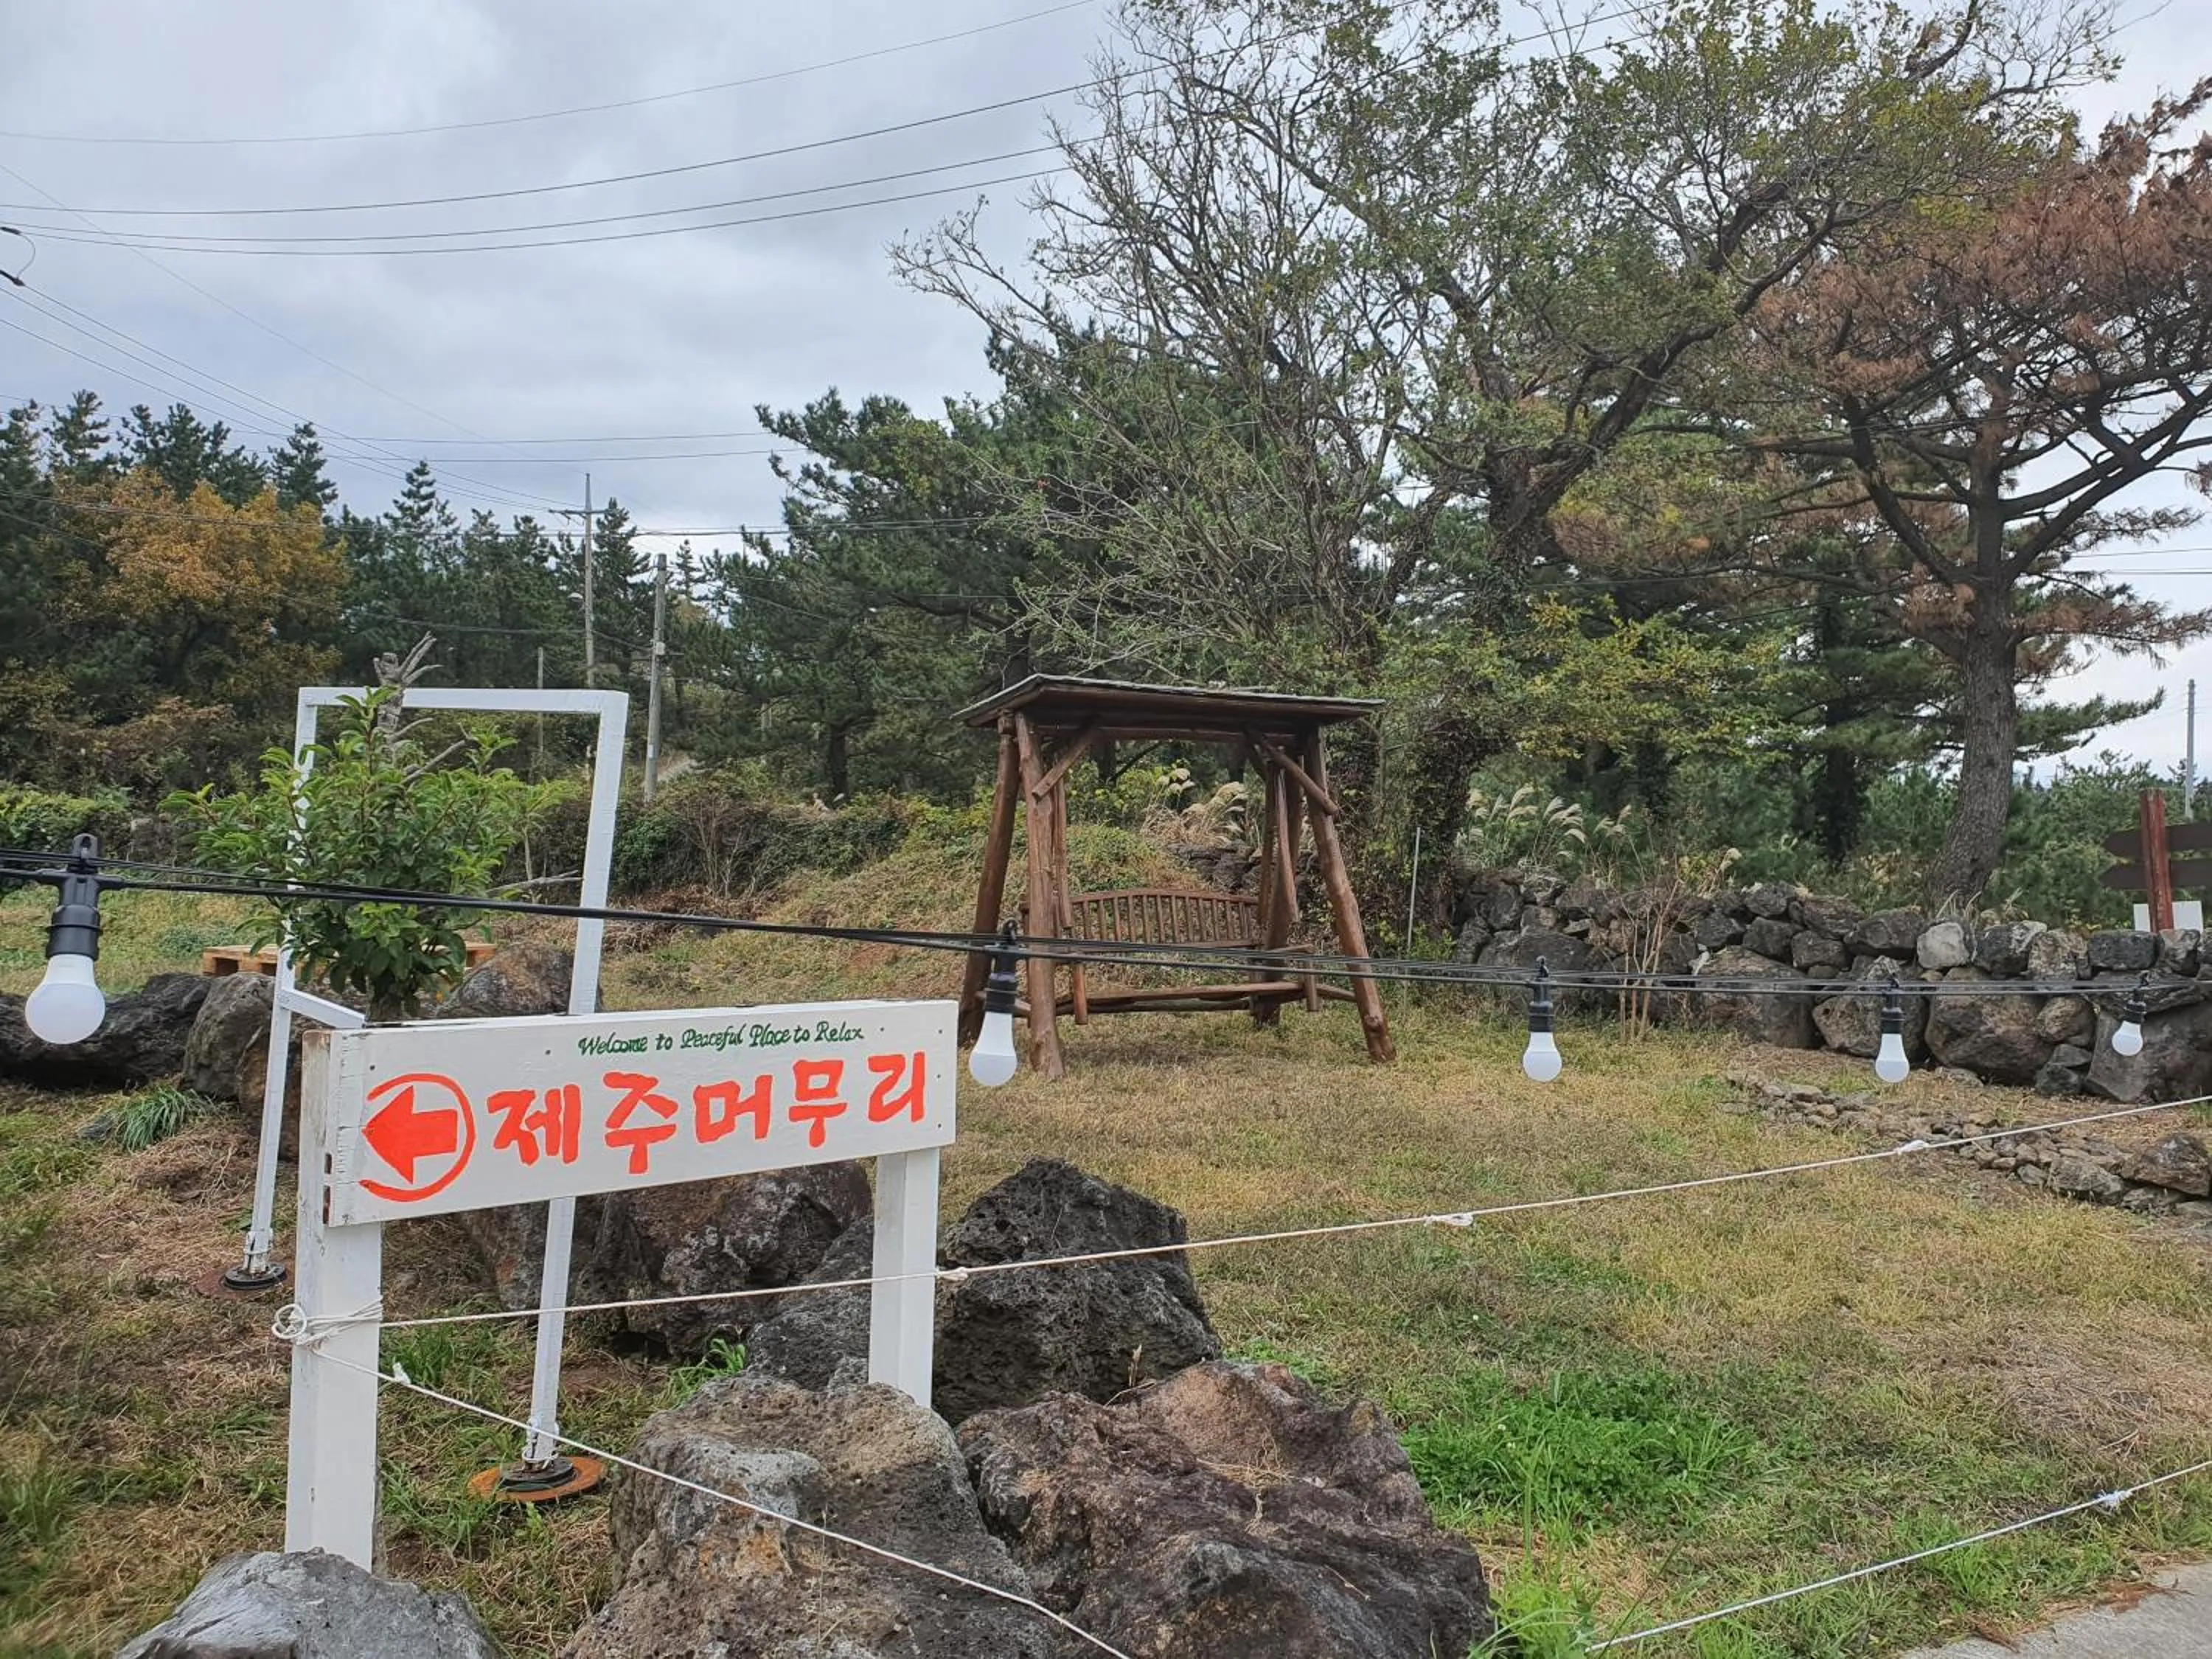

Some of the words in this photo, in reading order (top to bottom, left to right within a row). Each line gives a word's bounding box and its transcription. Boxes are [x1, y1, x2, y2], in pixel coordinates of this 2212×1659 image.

[577, 1032, 648, 1056] Welcome
[655, 1033, 674, 1051] to
[680, 1023, 746, 1052] Peaceful
[748, 1023, 792, 1048] Place
[793, 1027, 810, 1043] to
[814, 1020, 865, 1043] Relax
[487, 1051, 927, 1175] 제주머무리
